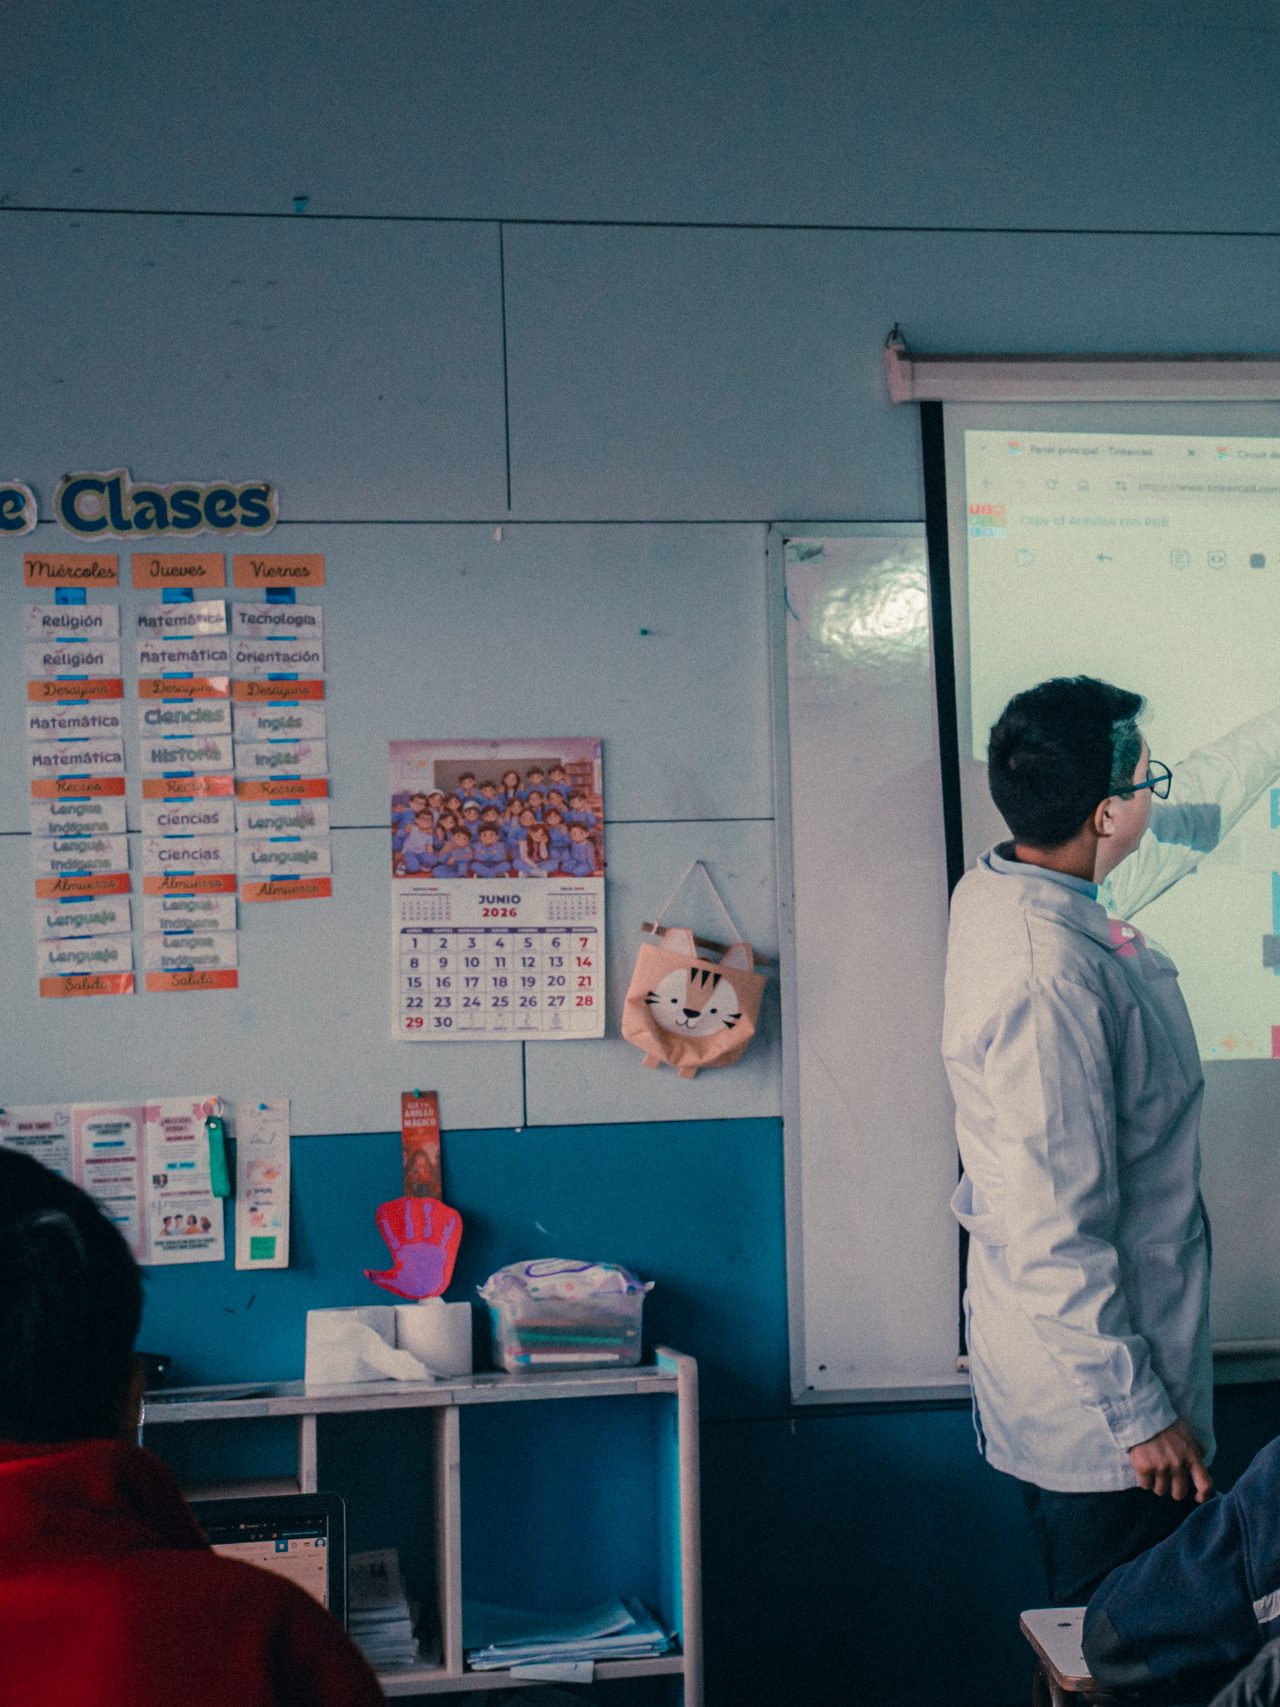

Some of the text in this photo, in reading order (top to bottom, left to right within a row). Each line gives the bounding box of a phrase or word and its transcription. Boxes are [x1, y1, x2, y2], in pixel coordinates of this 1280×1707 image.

[61, 477, 271, 531] Clases
[27, 561, 116, 578] Miércoles
[150, 561, 206, 577] Jueves
[250, 561, 310, 577] Viernes
[42, 615, 102, 628] Religión
[138, 613, 224, 627] Matemática
[239, 613, 316, 626] Tecnología
[43, 653, 103, 666] Religión
[141, 650, 227, 663] Matemática
[236, 651, 319, 663] Orientación
[44, 683, 108, 698] Desayuno
[247, 684, 310, 699] Desayuno
[30, 716, 119, 729] Matemática
[33, 752, 121, 766] Matemática
[157, 813, 219, 825] Ciencias
[159, 849, 219, 861] Ciencias
[479, 895, 521, 904] JUNIO
[482, 908, 517, 917] 2026
[412, 938, 589, 948] 1 2 3 4 5 6 7
[410, 956, 592, 968] 8 9 10 11 12 13 14
[407, 976, 592, 988] 15 16 17 18 19 20 21
[406, 996, 593, 1008] 22 23 24 25 26 27 28
[405, 1017, 452, 1028] 29 30
